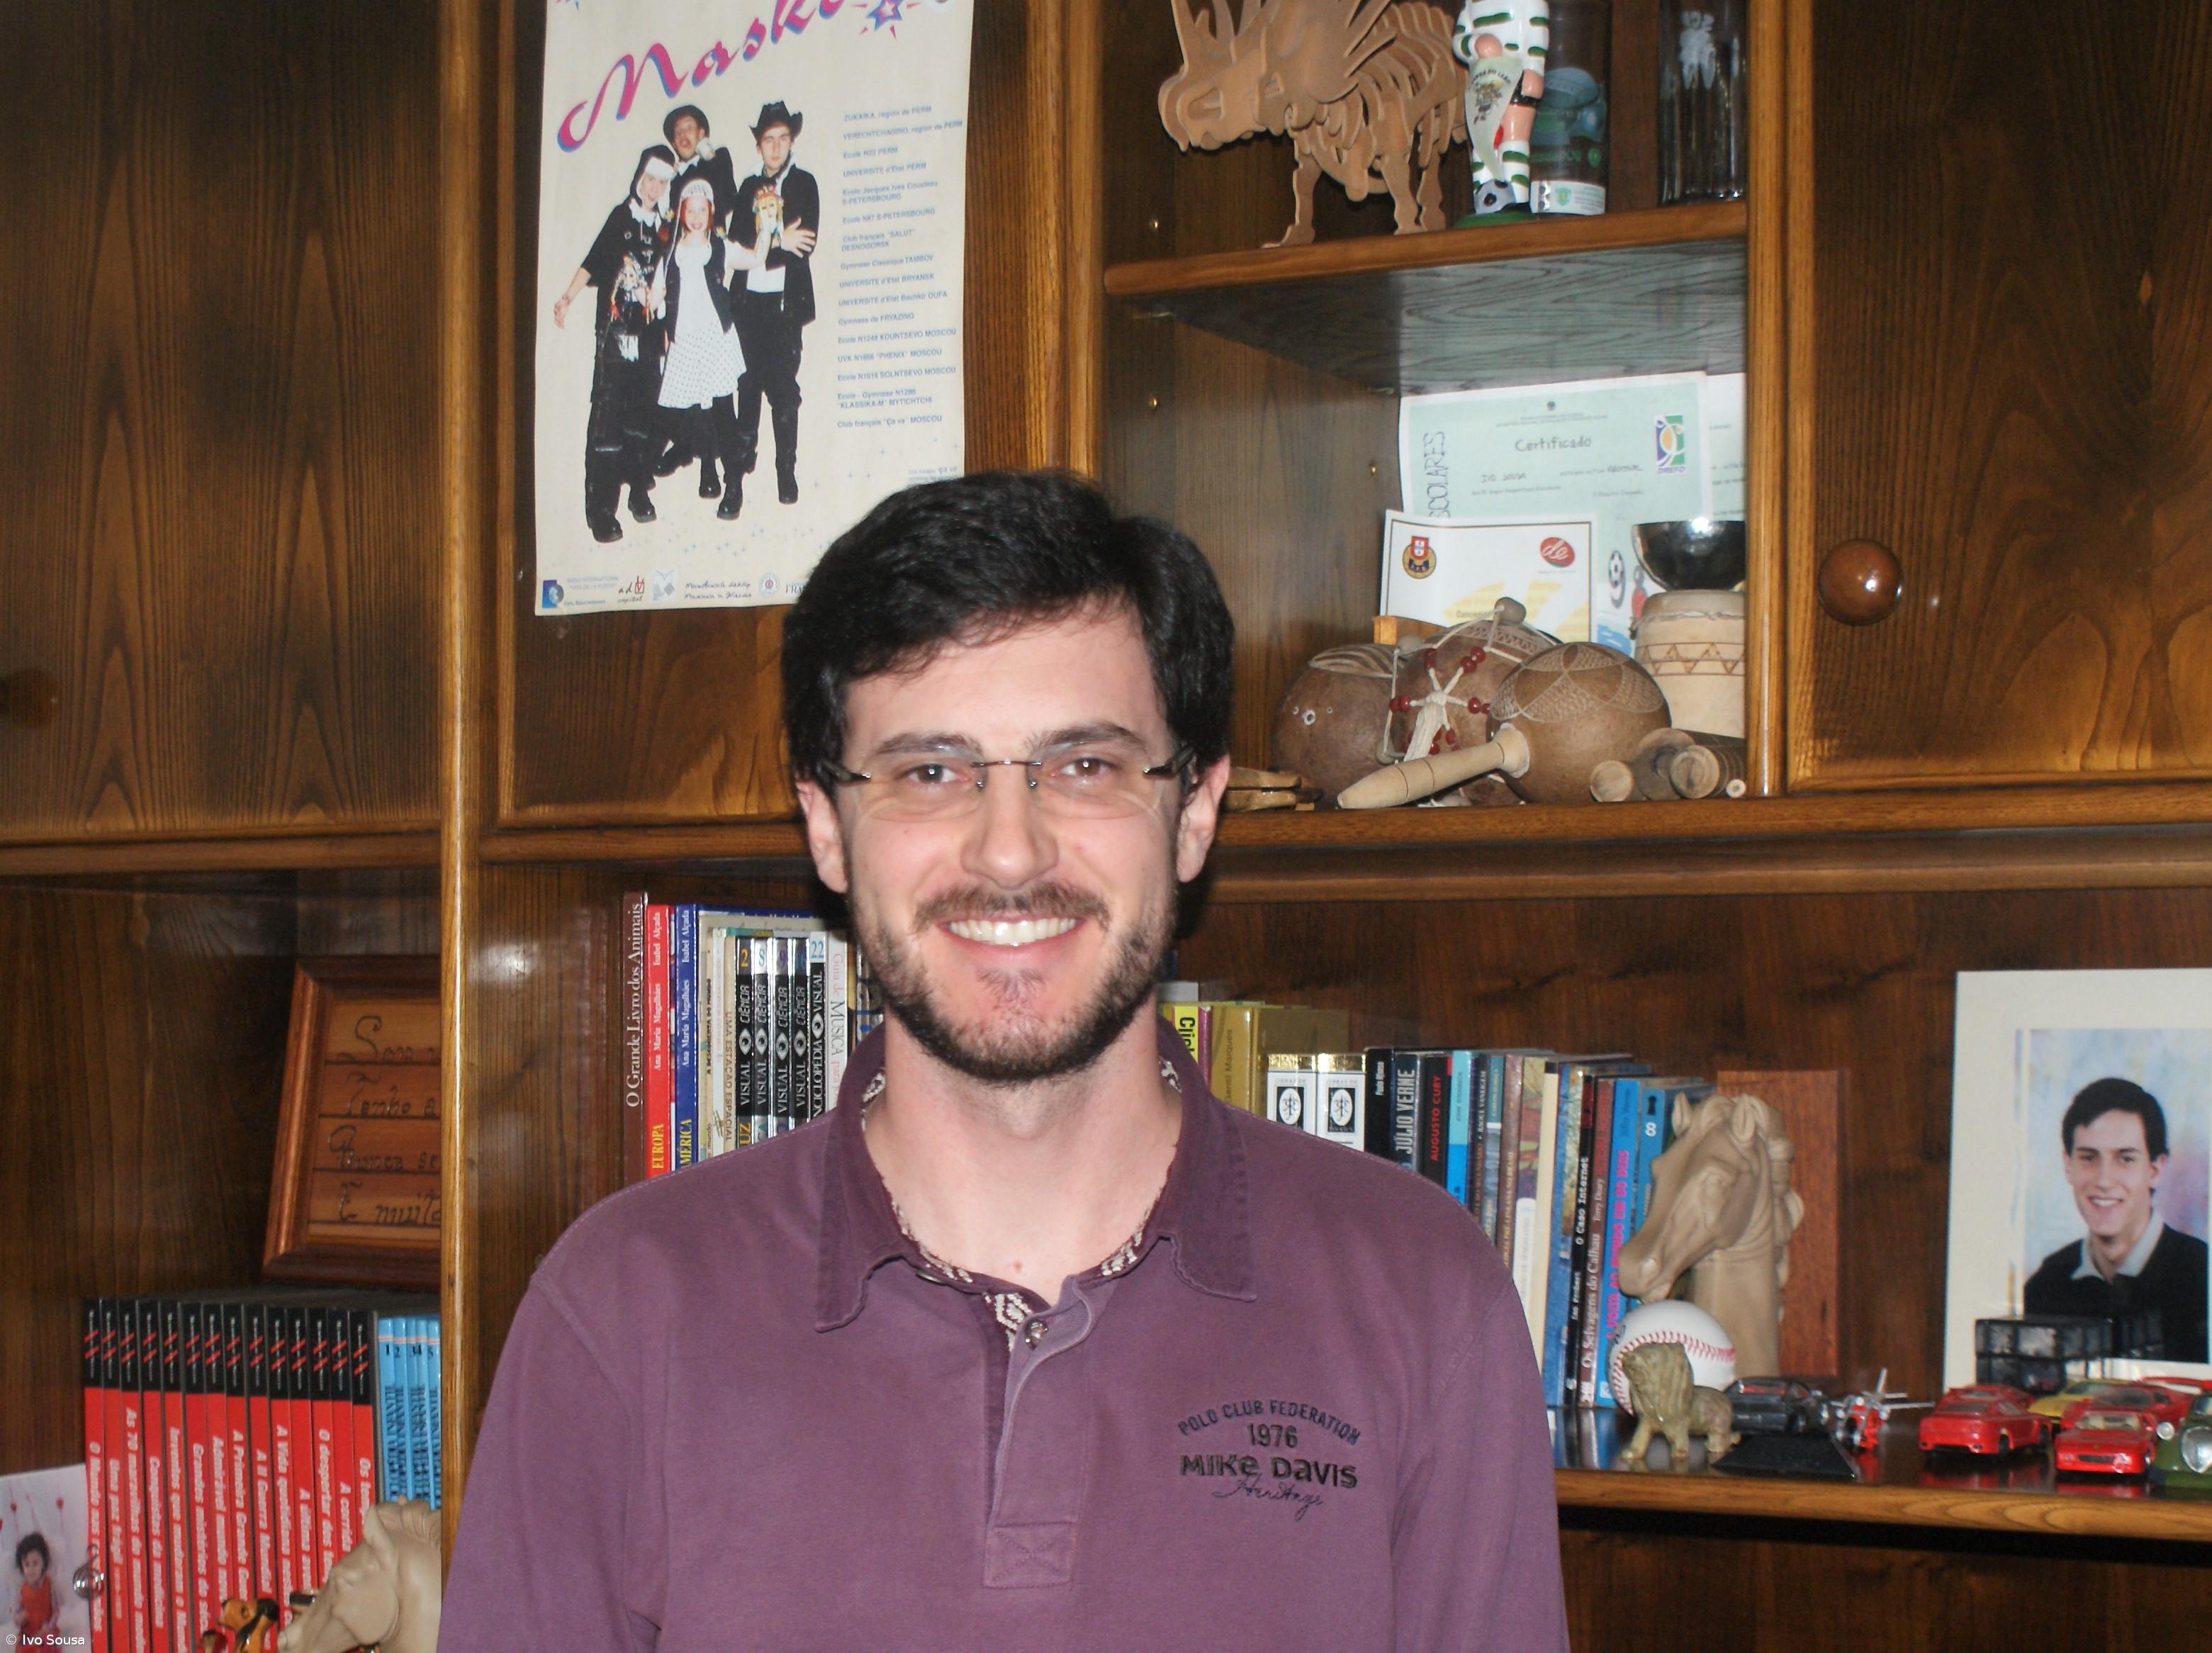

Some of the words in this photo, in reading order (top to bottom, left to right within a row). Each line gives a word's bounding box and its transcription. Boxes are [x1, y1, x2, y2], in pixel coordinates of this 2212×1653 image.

[944, 120, 962, 128] PERM
[906, 162, 926, 171] PERM
[839, 279, 880, 288] UNIVERSITE
[838, 296, 878, 306] UNIVERSITE
[880, 369, 923, 378] SOLNTSEVO
[1515, 435, 1592, 453] Certificado
[627, 904, 641, 963] Animais
[653, 912, 662, 938] Alçada
[681, 910, 691, 936] Alçada
[653, 943, 661, 965] Isabel
[681, 940, 690, 962] Isabel
[741, 948, 748, 967] 2
[758, 949, 765, 968] 8
[811, 941, 824, 958] 22
[627, 967, 641, 990] dos
[832, 953, 844, 981] Guia
[653, 983, 663, 1024] Magalhães
[681, 980, 691, 1020] Magalhães
[812, 970, 822, 1012] VISUAL
[833, 983, 843, 996] de
[627, 993, 641, 1031] Livro
[739, 985, 751, 1024] CIÊNCIA
[775, 987, 788, 1027] CIÊNCIA
[795, 986, 806, 1025] CIÊNCIA
[681, 1024, 690, 1048] Maria
[626, 1035, 641, 1088] Grande
[1225, 1030, 1233, 1072] Marques
[740, 1061, 751, 1105] VISUAL
[757, 1059, 766, 1104] VISUAL
[777, 1065, 788, 1113] VISUAL
[795, 1061, 806, 1106] VISUAL
[1397, 1069, 1415, 1111] VERNE
[1432, 1075, 1441, 1104] CURY
[626, 1092, 639, 1107] O
[651, 1124, 664, 1170] EUROPA
[1394, 1116, 1413, 1154] JÚLIO
[1430, 1108, 1440, 1161] AUGUSTO
[1616, 1150, 1629, 1177] DIAS
[1577, 1157, 1588, 1204] Internet
[1595, 1178, 1605, 1201] Deary
[1616, 1182, 1627, 1197] 80
[1576, 1209, 1585, 1233] Caso
[1593, 1203, 1602, 1221] Terry
[1613, 1201, 1626, 1219] EM
[1585, 1276, 1598, 1290] do
[1583, 1293, 1598, 1349] Selvagens
[1606, 1292, 1619, 1328] VOLTA
[1582, 1351, 1593, 1368] Os
[126, 1408, 137, 1428] As
[276, 1424, 287, 1436] A
[1178, 1409, 1218, 1435] POLO
[1222, 1400, 1264, 1418] CLUB
[1270, 1399, 1361, 1445] FEDERATION
[89, 1442, 100, 1453] O
[127, 1433, 138, 1451] 70
[232, 1430, 243, 1441] A
[319, 1429, 330, 1441] O
[1247, 1423, 1298, 1447] 1976
[169, 1427, 181, 1489] Inventos
[256, 1449, 266, 1462] A
[277, 1440, 288, 1474] Vida
[359, 1457, 370, 1478] Os
[89, 1457, 101, 1506] Mundo
[108, 1459, 120, 1491] Uma
[193, 1443, 205, 1503] Grandes
[212, 1435, 227, 1511] Admirável
[233, 1445, 245, 1508] Primeira
[319, 1444, 332, 1515] despertar
[340, 1481, 351, 1494] A
[128, 1454, 140, 1532] maravilhas
[149, 1457, 162, 1535] Conquistas
[170, 1493, 181, 1520] que
[257, 1480, 269, 1529] Guerra
[299, 1488, 310, 1501] A
[109, 1495, 120, 1521] paz
[278, 1477, 291, 1554] quotidiana
[236, 1511, 248, 1564] Grande
[300, 1503, 311, 1551] última
[322, 1519, 333, 1547] dos
[340, 1497, 352, 1552] corrida
[131, 1536, 141, 1555] do
[195, 1506, 208, 1575] mistérios
[216, 1514, 228, 1565] mundo
[172, 1524, 184, 1593] mudaram
[259, 1532, 272, 1593] Mundial
[132, 1559, 143, 1608] mundo
[153, 1562, 164, 1627] medicina
[198, 1577, 209, 1597] do
[175, 1596, 184, 1607] o
